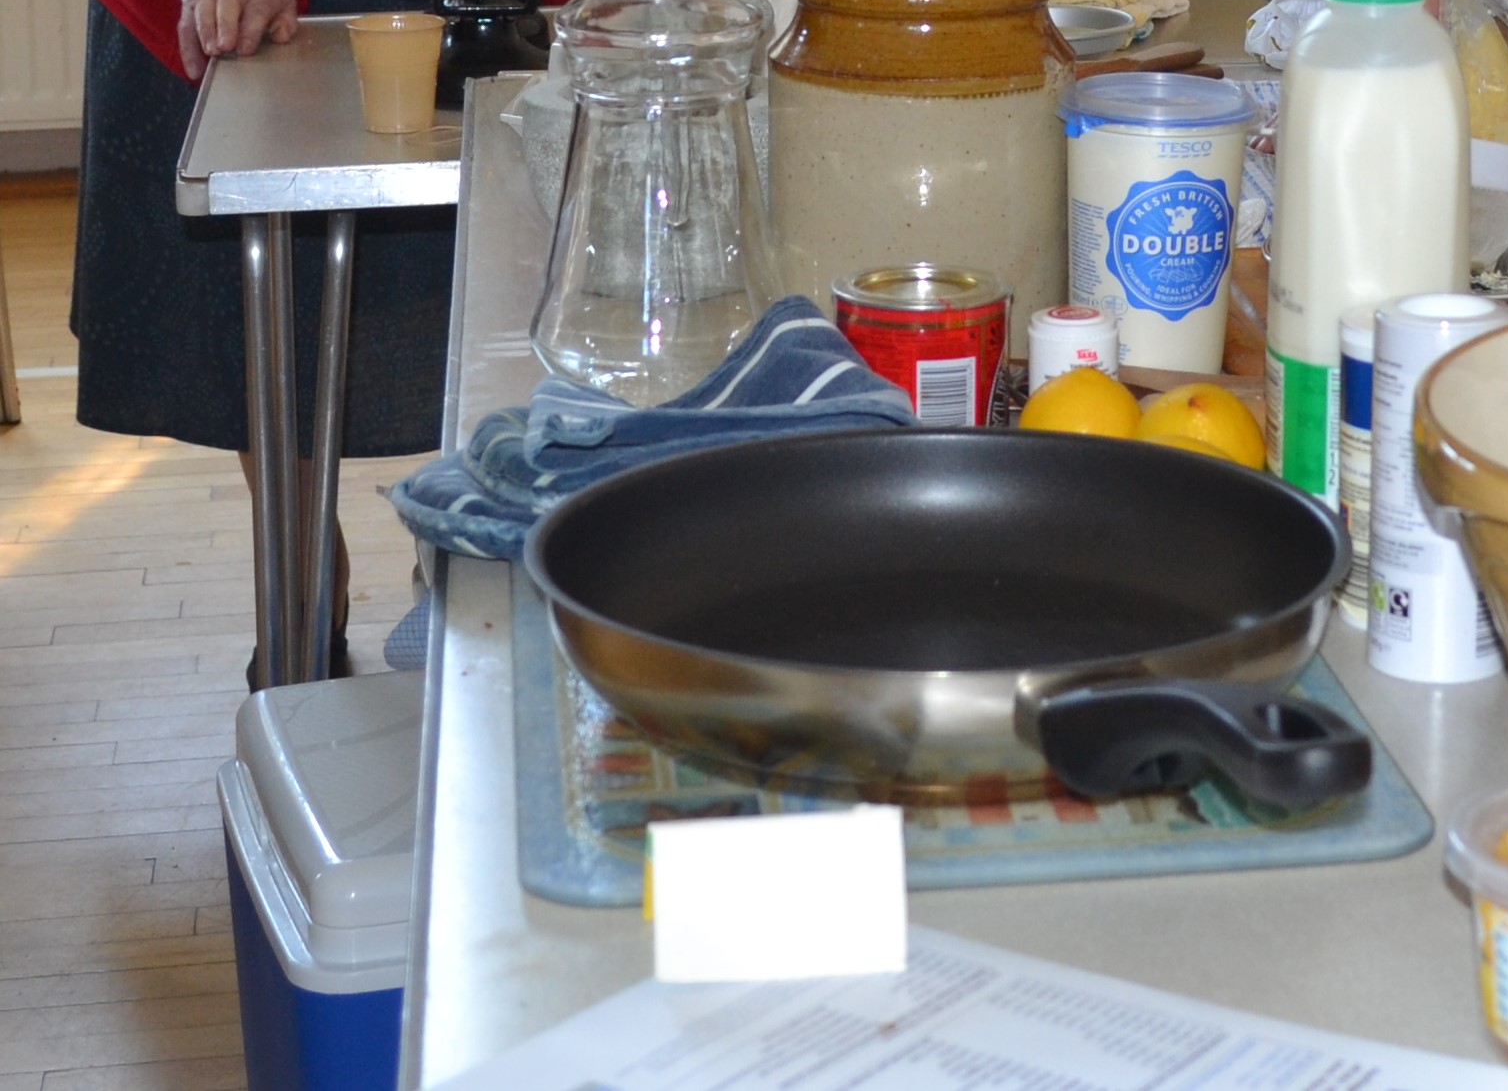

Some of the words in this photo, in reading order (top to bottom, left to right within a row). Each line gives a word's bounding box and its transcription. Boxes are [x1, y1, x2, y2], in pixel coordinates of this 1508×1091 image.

[1157, 140, 1213, 154] TESCO
[1128, 192, 1172, 226] FRESH
[1178, 190, 1224, 221] BRITISH
[1122, 231, 1224, 256] DOUBLE
[1160, 257, 1195, 267] CREAM
[1157, 284, 1180, 295] IDEAL
[1181, 283, 1196, 293] FOR
[1153, 293, 1193, 303] WHIPPING
